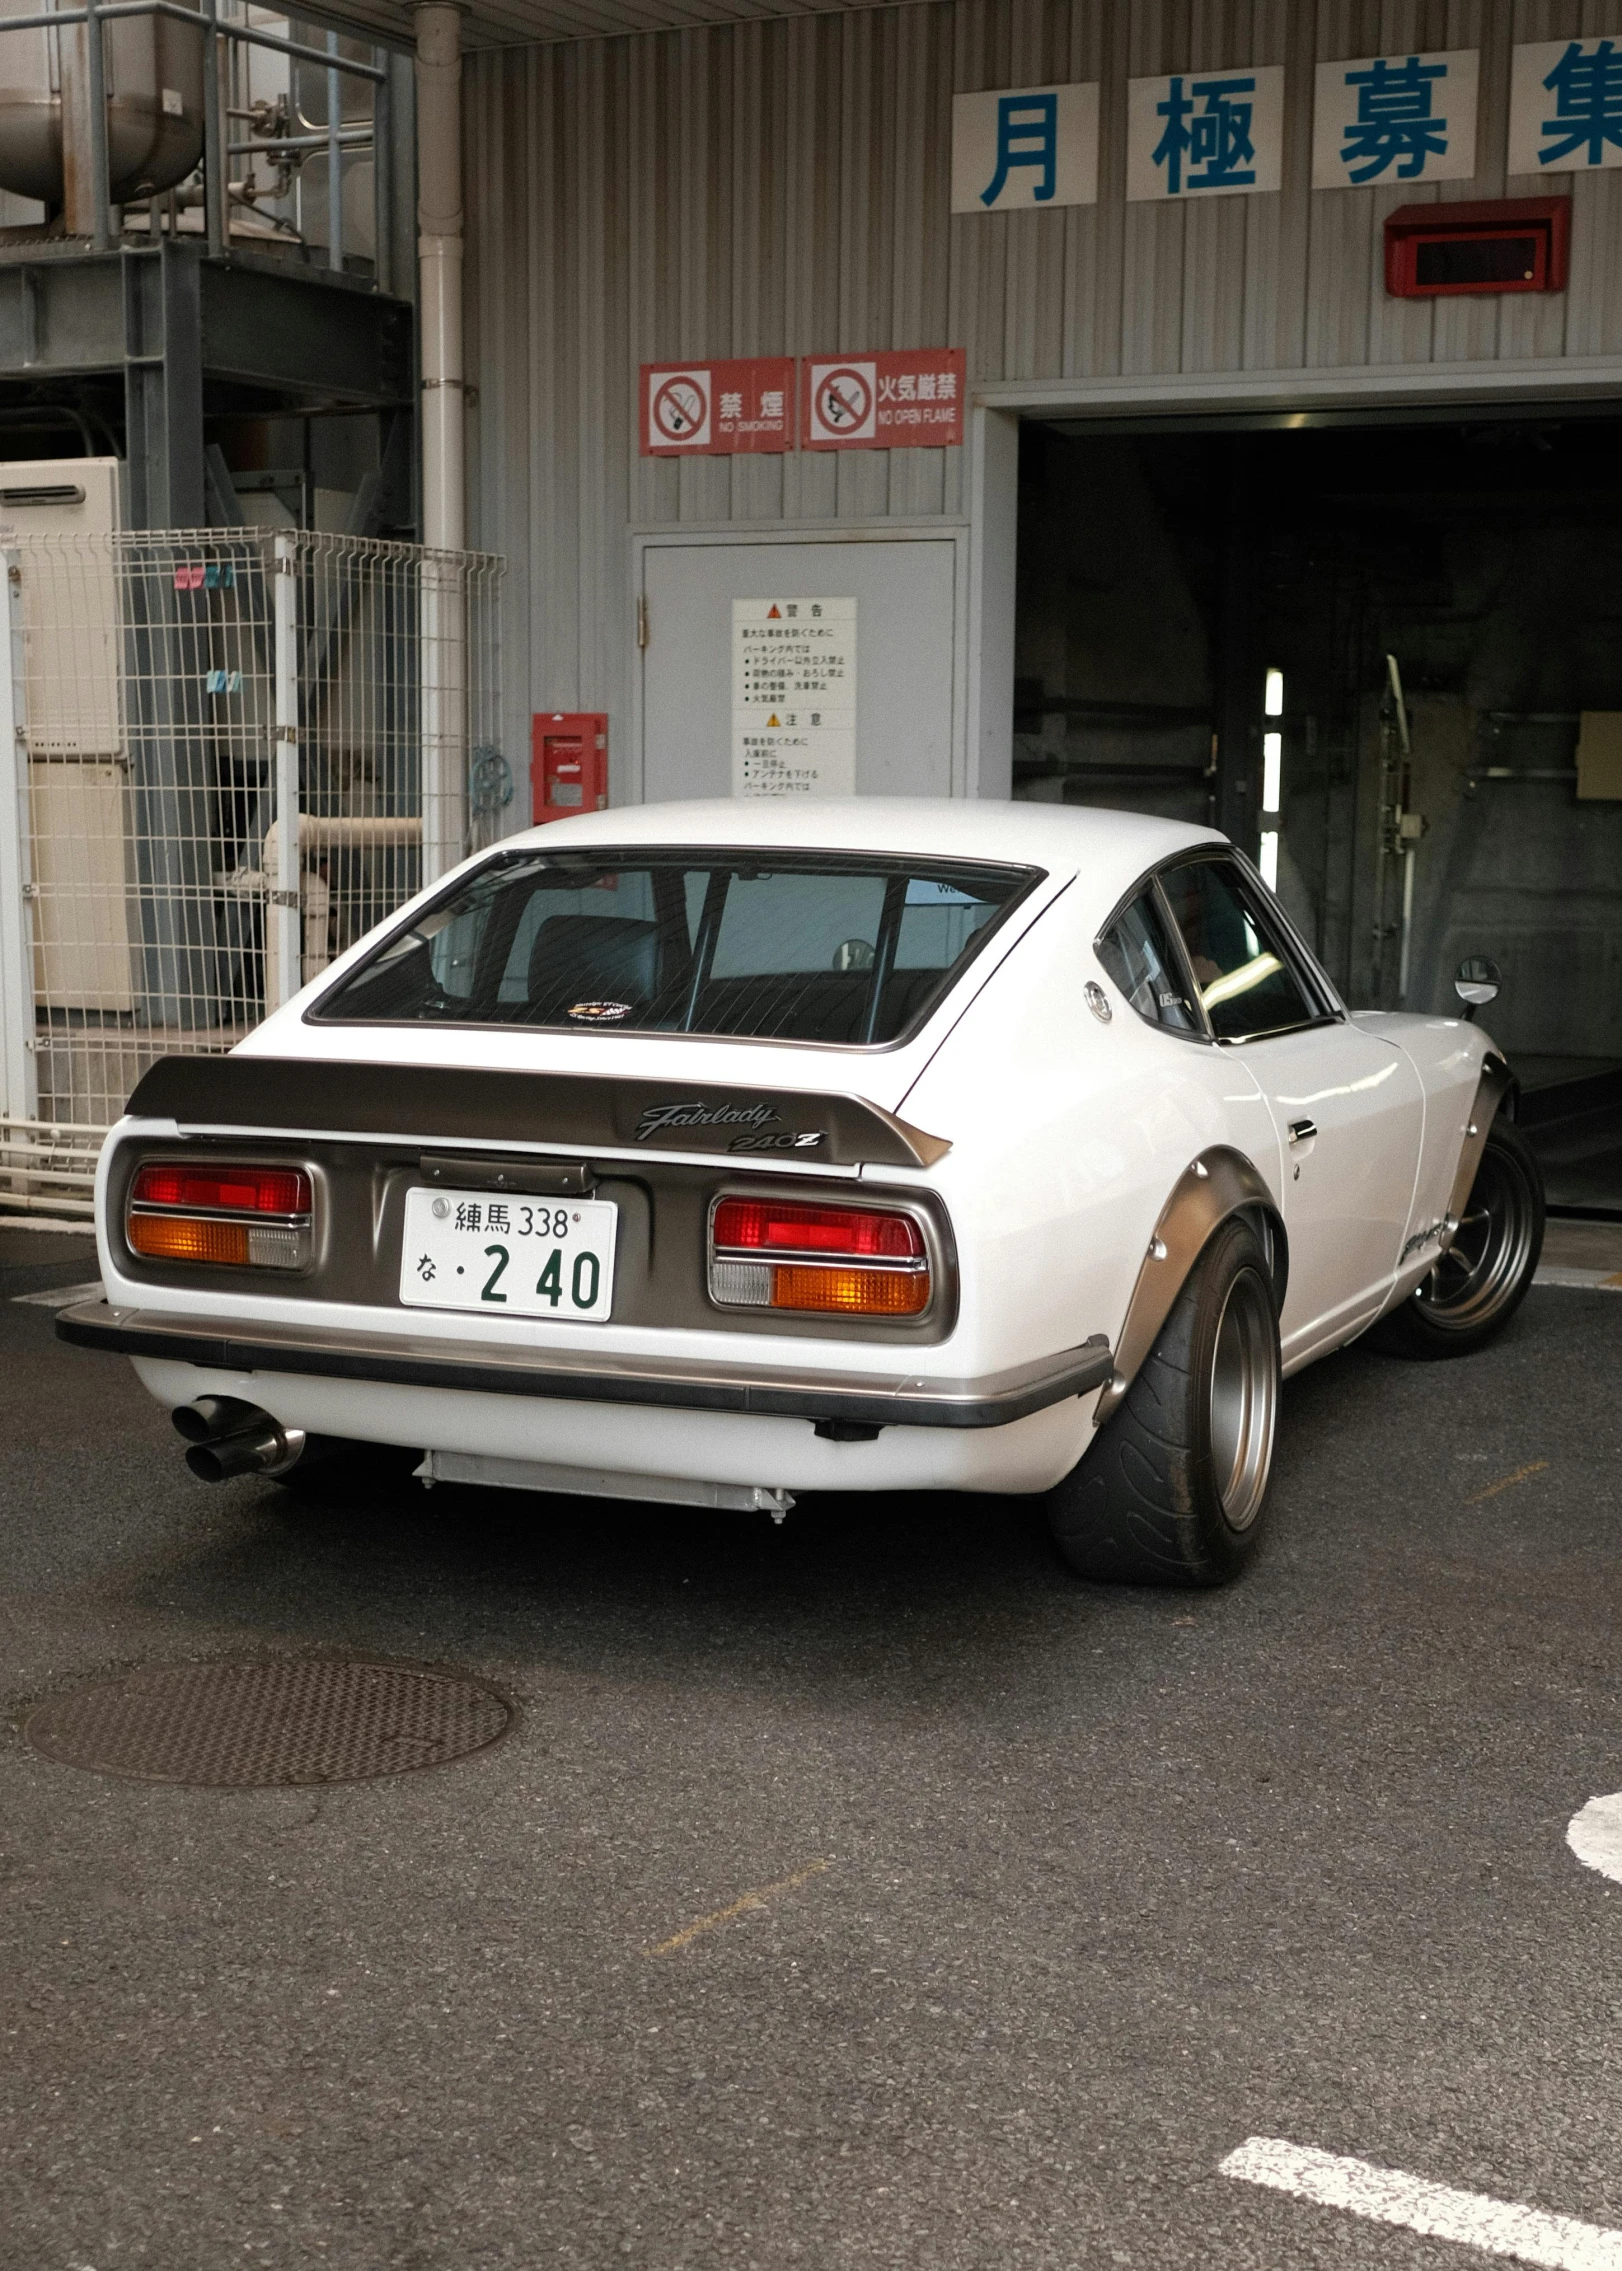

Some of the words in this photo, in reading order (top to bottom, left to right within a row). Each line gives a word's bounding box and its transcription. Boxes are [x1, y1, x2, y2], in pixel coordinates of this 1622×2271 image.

[878, 373, 957, 402] 火気厳禁
[720, 391, 784, 419] 禁煙
[878, 410, 893, 426] NO
[894, 409, 921, 425] OPEN
[923, 407, 956, 424] FLAME
[719, 420, 735, 433] NO
[738, 419, 783, 432] SMOKING
[636, 1102, 781, 1141] Fairlady
[730, 1132, 823, 1151] 240Z
[454, 1202, 511, 1234] 練馬
[518, 1207, 569, 1238] 338
[416, 1253, 437, 1282] な
